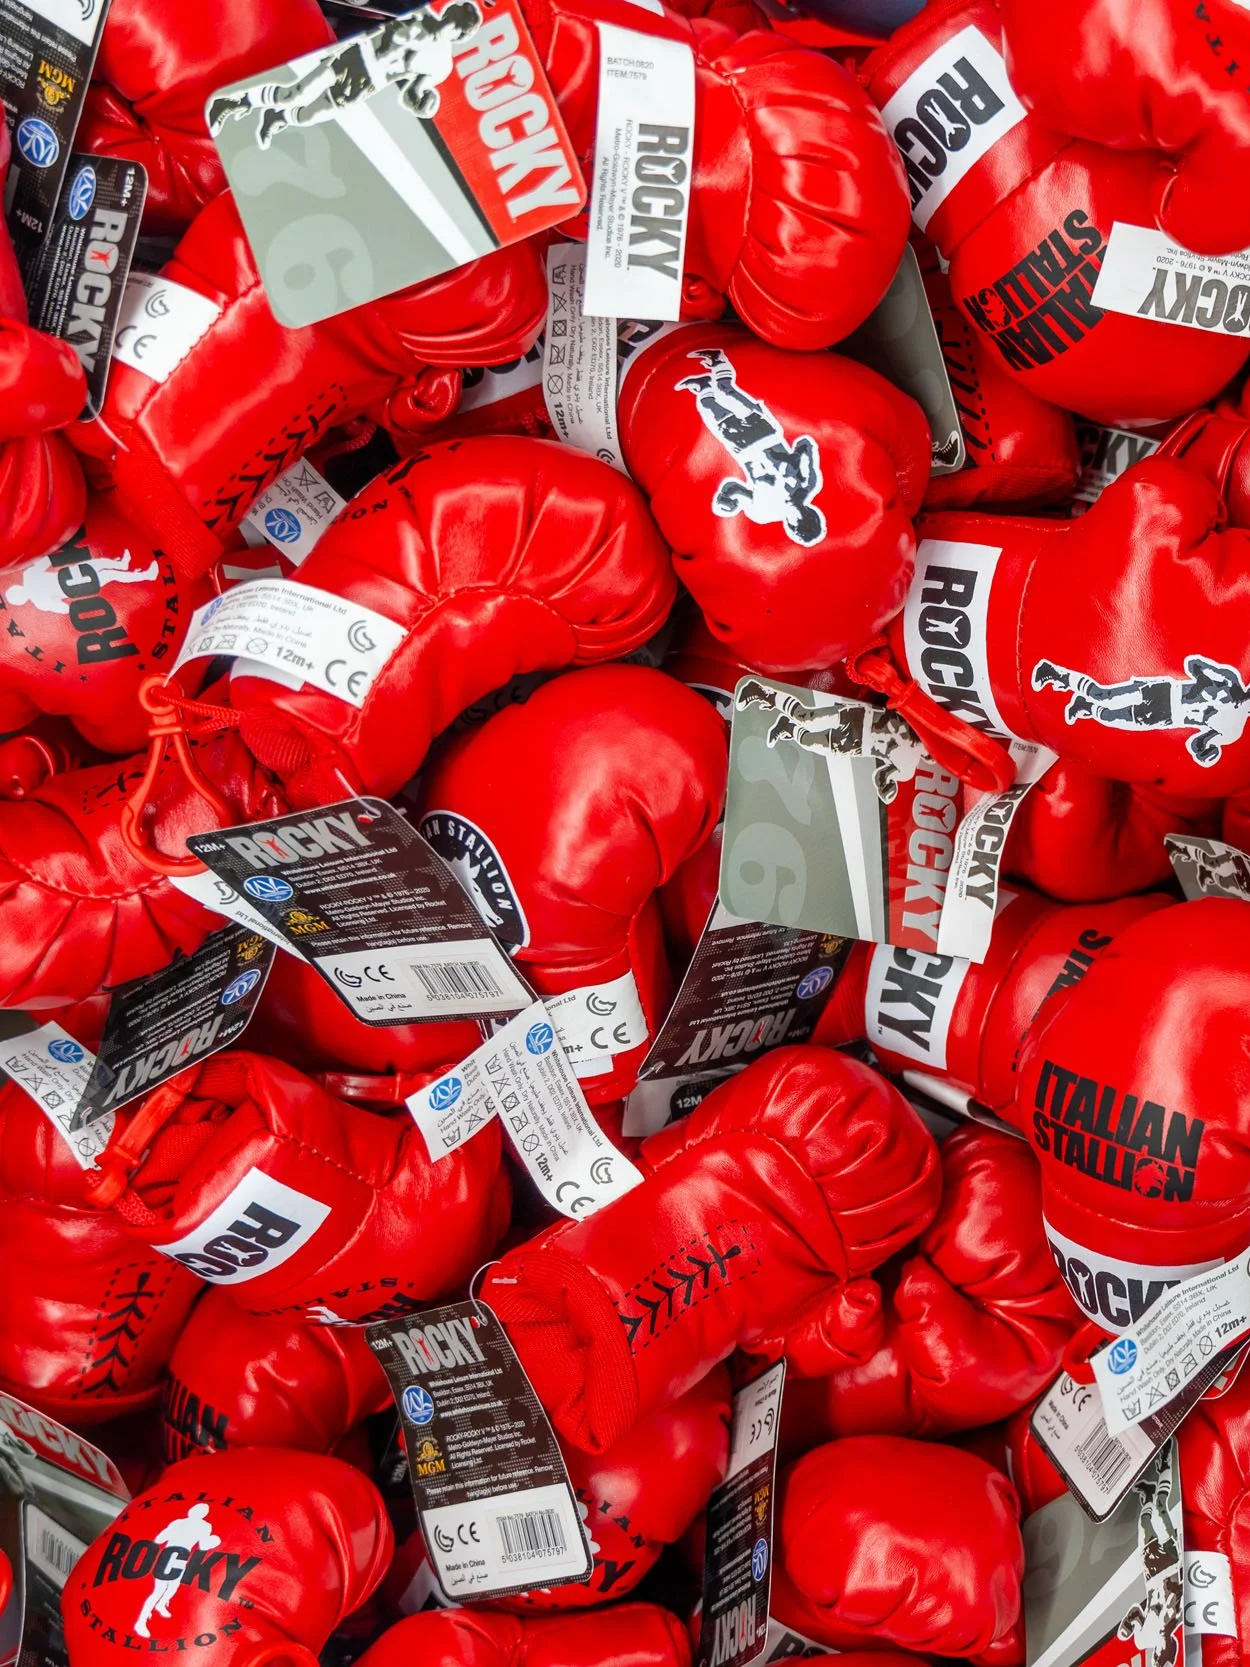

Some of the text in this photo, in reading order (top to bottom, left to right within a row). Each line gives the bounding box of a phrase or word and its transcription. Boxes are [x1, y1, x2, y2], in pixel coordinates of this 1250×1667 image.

[451, 12, 582, 220] ROCKY
[895, 55, 1005, 212] ROCK
[118, 167, 136, 206] 12M+
[598, 156, 609, 192] All Rights
[626, 123, 689, 280] ROCKY
[605, 215, 615, 243] Studios
[614, 248, 622, 268] 2020
[1156, 255, 1174, 264] 2020
[79, 208, 126, 378] ROCKY
[963, 209, 1107, 332] STALLION
[1179, 260, 1196, 269] 1976
[553, 401, 568, 439] 12m+
[48, 523, 140, 664] ROCK
[273, 644, 317, 671] 12m+
[918, 565, 1008, 740] ROCK
[193, 838, 226, 856] 12M+
[226, 809, 373, 871] ROCKY
[445, 817, 513, 910] STALLION
[903, 759, 964, 953] ROCKY
[965, 785, 1024, 911] ROCKY
[290, 918, 332, 937] MGM
[355, 988, 406, 1005] Made in China
[877, 947, 954, 1052] CKY
[109, 1014, 224, 1106] ROCKY
[677, 1004, 798, 1067] ROCKY
[500, 1046, 561, 1162] Hand Wash Made China
[546, 1048, 572, 1083] Whitehouse
[562, 1080, 581, 1103] Leisure
[591, 1134, 603, 1148] Ltd
[1034, 1060, 1206, 1168] ITALIAN
[532, 1151, 558, 1183] 12m+
[1034, 1115, 1196, 1202] STALLION
[1047, 1237, 1181, 1327] ROCK
[1180, 1268, 1227, 1298] International
[1226, 1263, 1240, 1275] Ltd
[370, 1338, 393, 1351] 12M+
[397, 1315, 487, 1376] ROCKY
[1212, 1311, 1250, 1339] 12m+
[416, 1459, 446, 1476] MGM
[120, 1490, 275, 1543] ITALIAN
[95, 1533, 262, 1605] ROCKY
[445, 1562, 462, 1571] Made
[468, 1558, 486, 1567] China
[80, 1596, 244, 1653] STALLION
